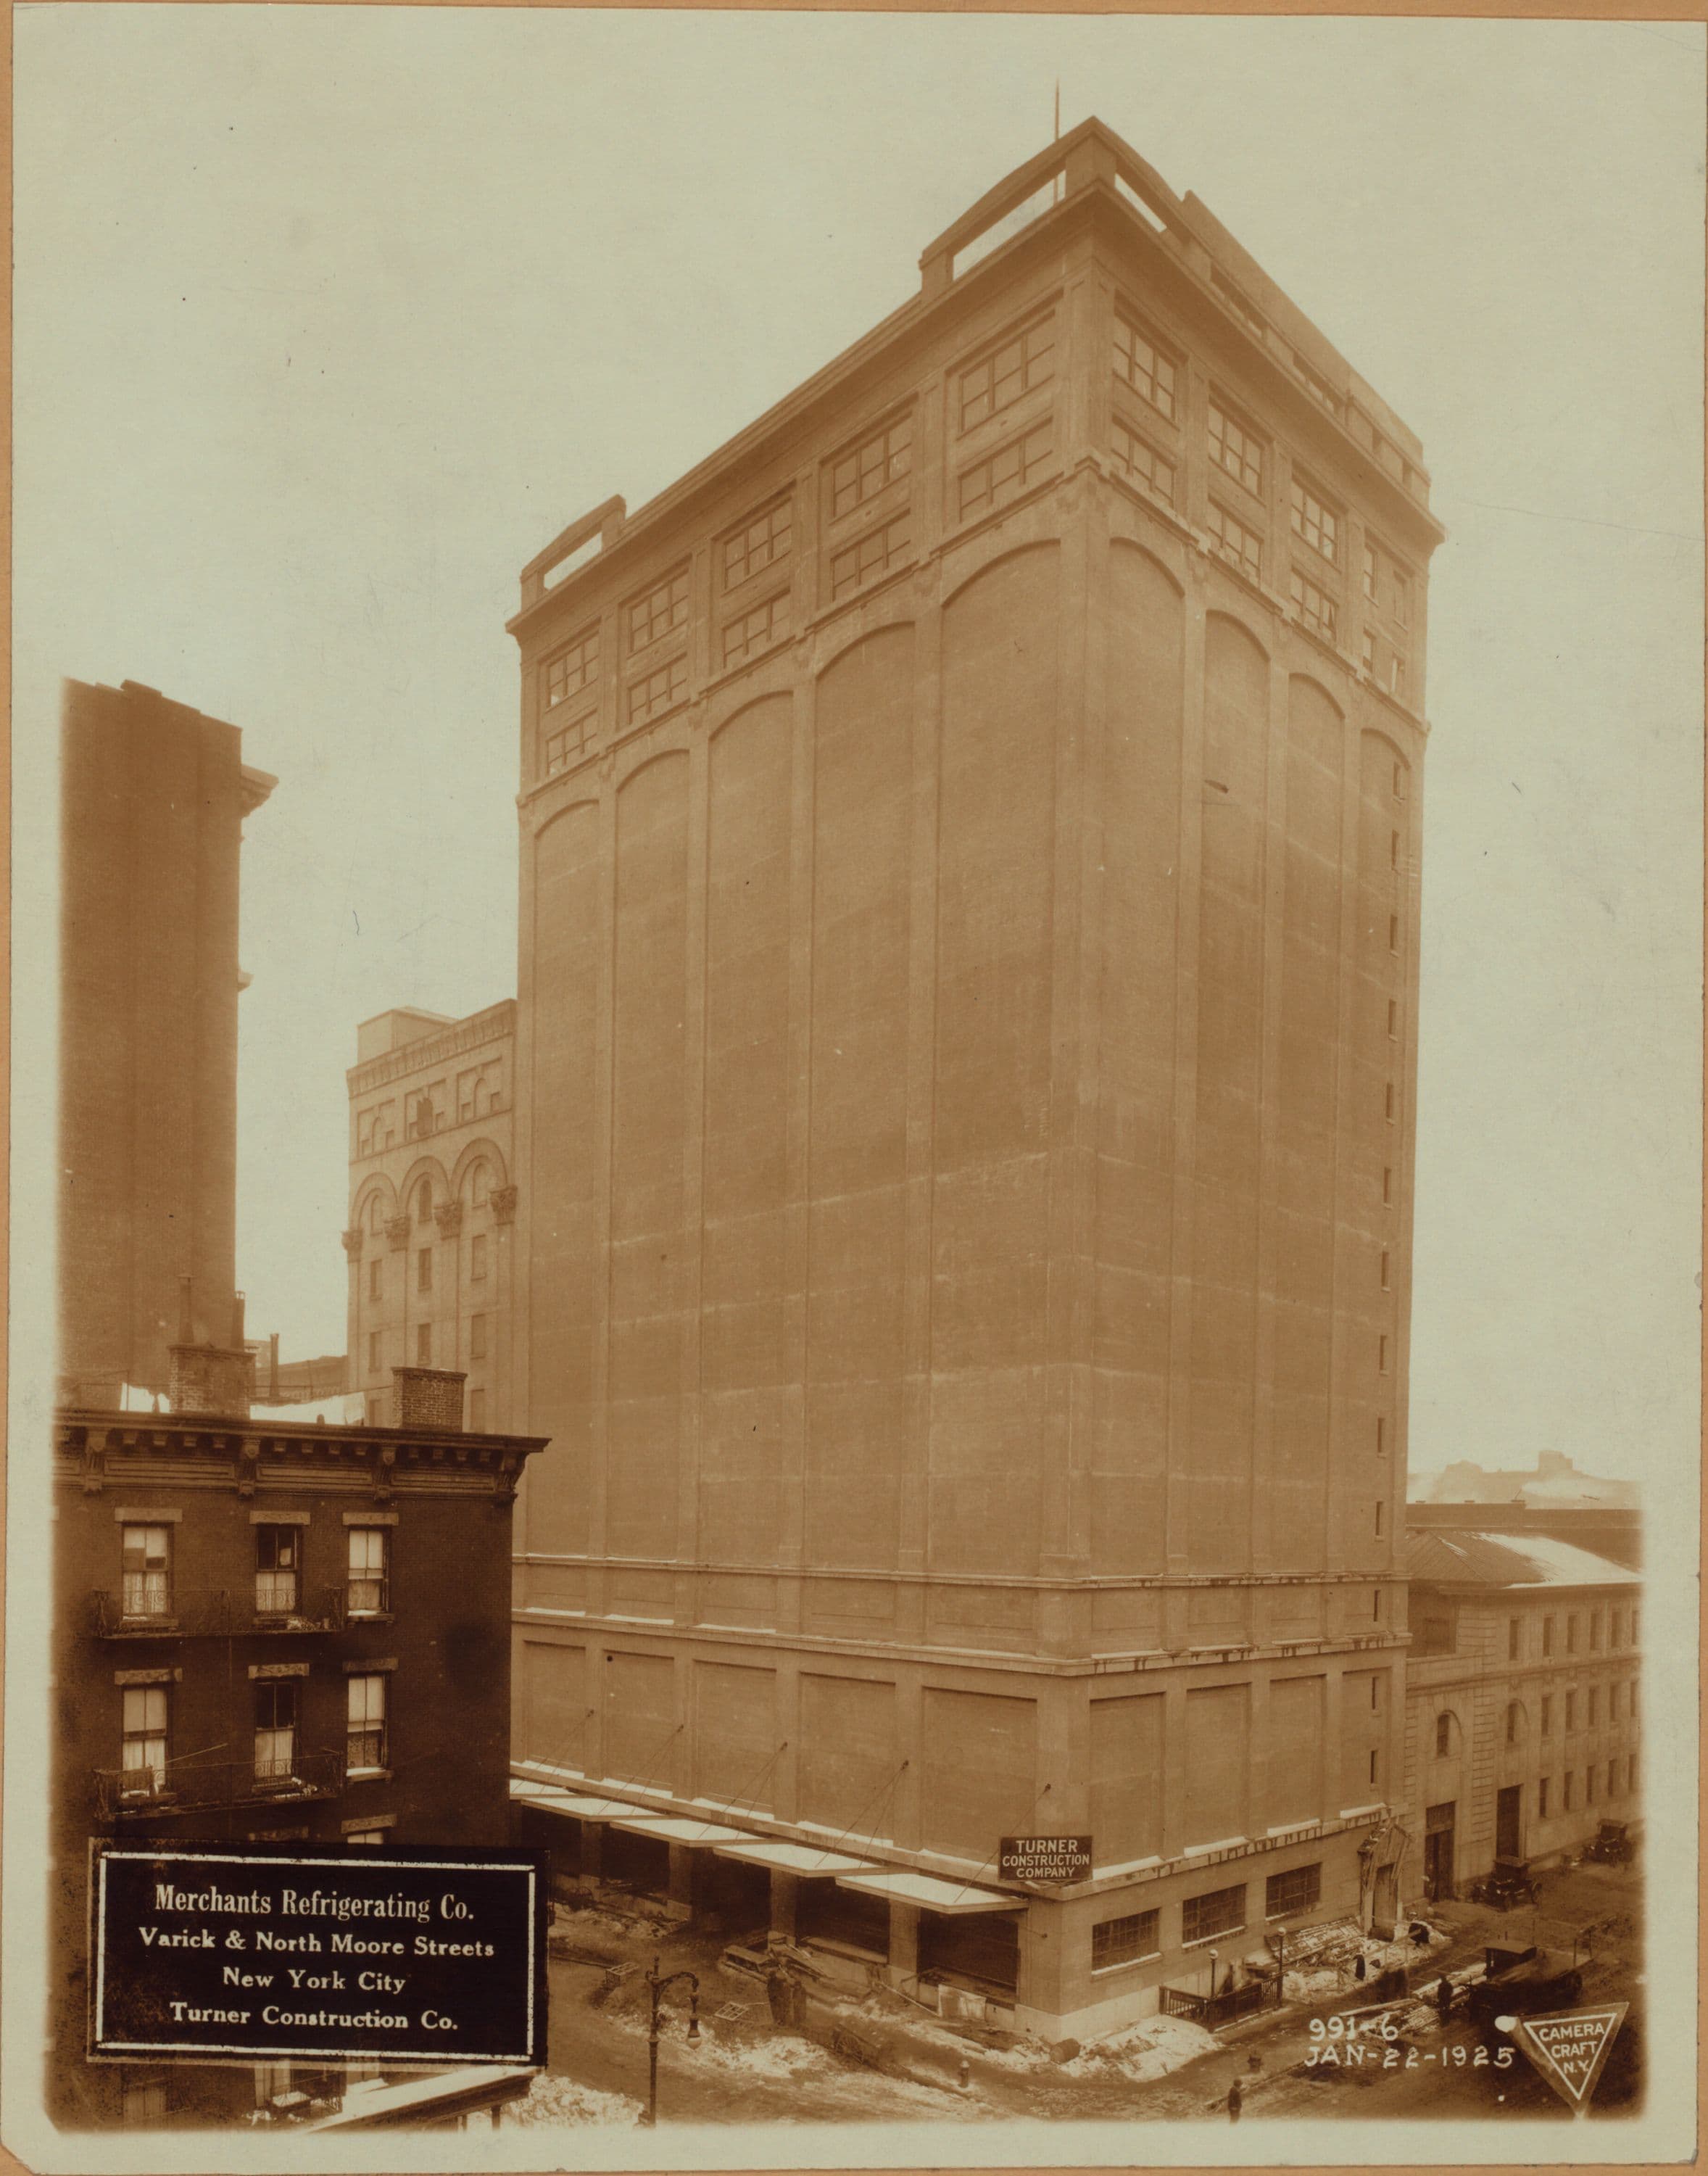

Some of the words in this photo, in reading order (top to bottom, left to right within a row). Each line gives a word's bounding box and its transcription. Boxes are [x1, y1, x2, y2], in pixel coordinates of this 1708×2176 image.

[1016, 1840, 1078, 1853] TURNER
[1002, 1854, 1090, 1867] CONSTRUCTION
[1016, 1867, 1076, 1878] COMPANY
